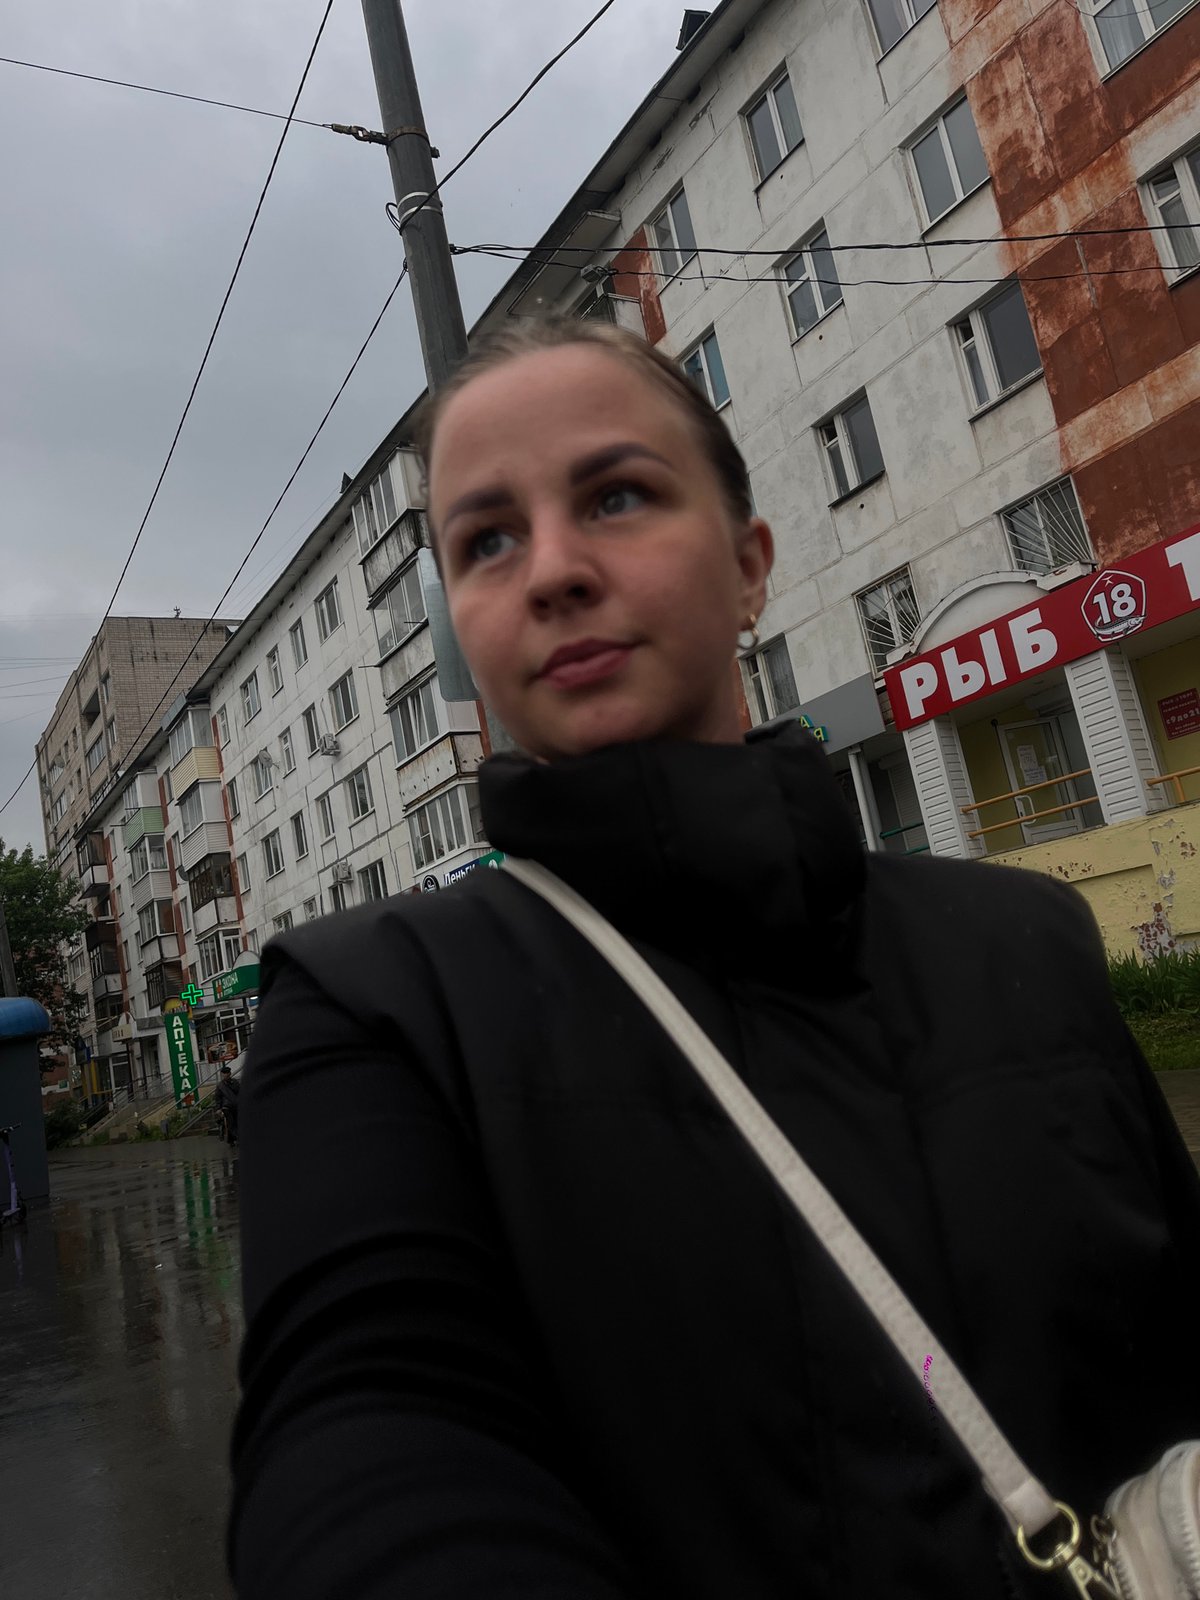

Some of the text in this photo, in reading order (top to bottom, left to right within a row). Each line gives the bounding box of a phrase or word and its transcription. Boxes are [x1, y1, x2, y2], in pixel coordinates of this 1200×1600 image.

[899, 607, 1058, 720] РЫБ
[1092, 582, 1137, 625] 18
[172, 1015, 192, 1090] АПТЕКА
